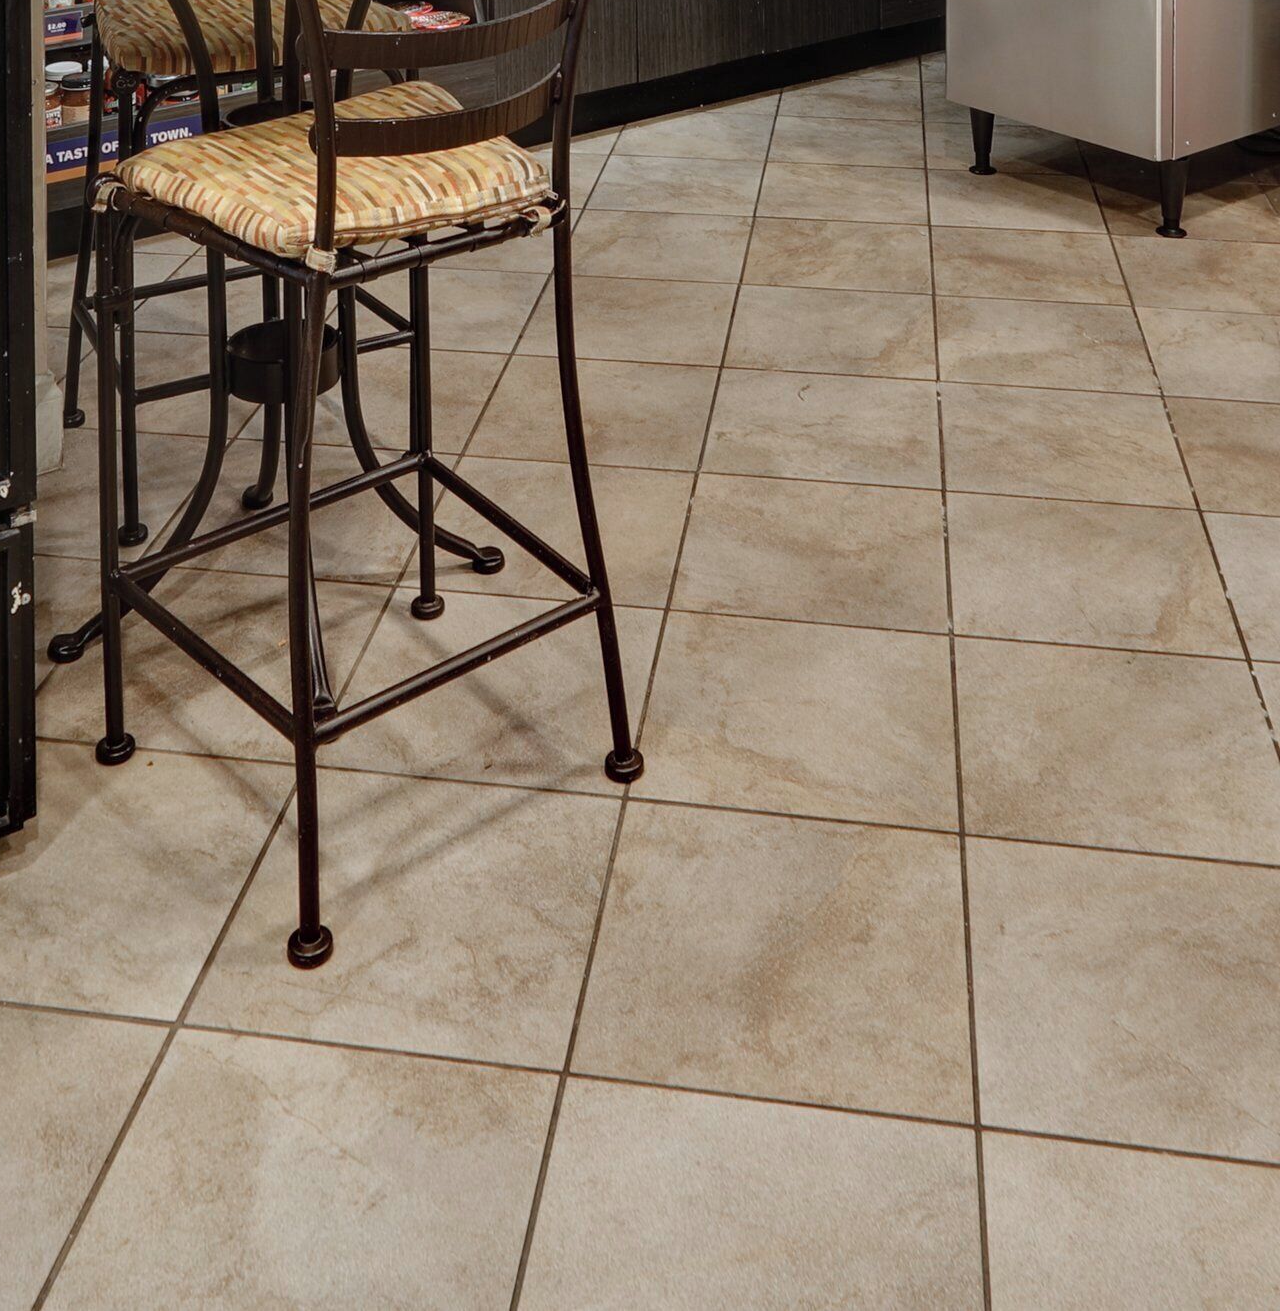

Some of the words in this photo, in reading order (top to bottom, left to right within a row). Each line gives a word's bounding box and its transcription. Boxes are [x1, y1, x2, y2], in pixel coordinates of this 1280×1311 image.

[47, 21, 67, 31] $2.00
[46, 153, 54, 165] A
[56, 148, 89, 164] TAST
[101, 140, 119, 153] OF
[150, 126, 193, 145] TOWN.
